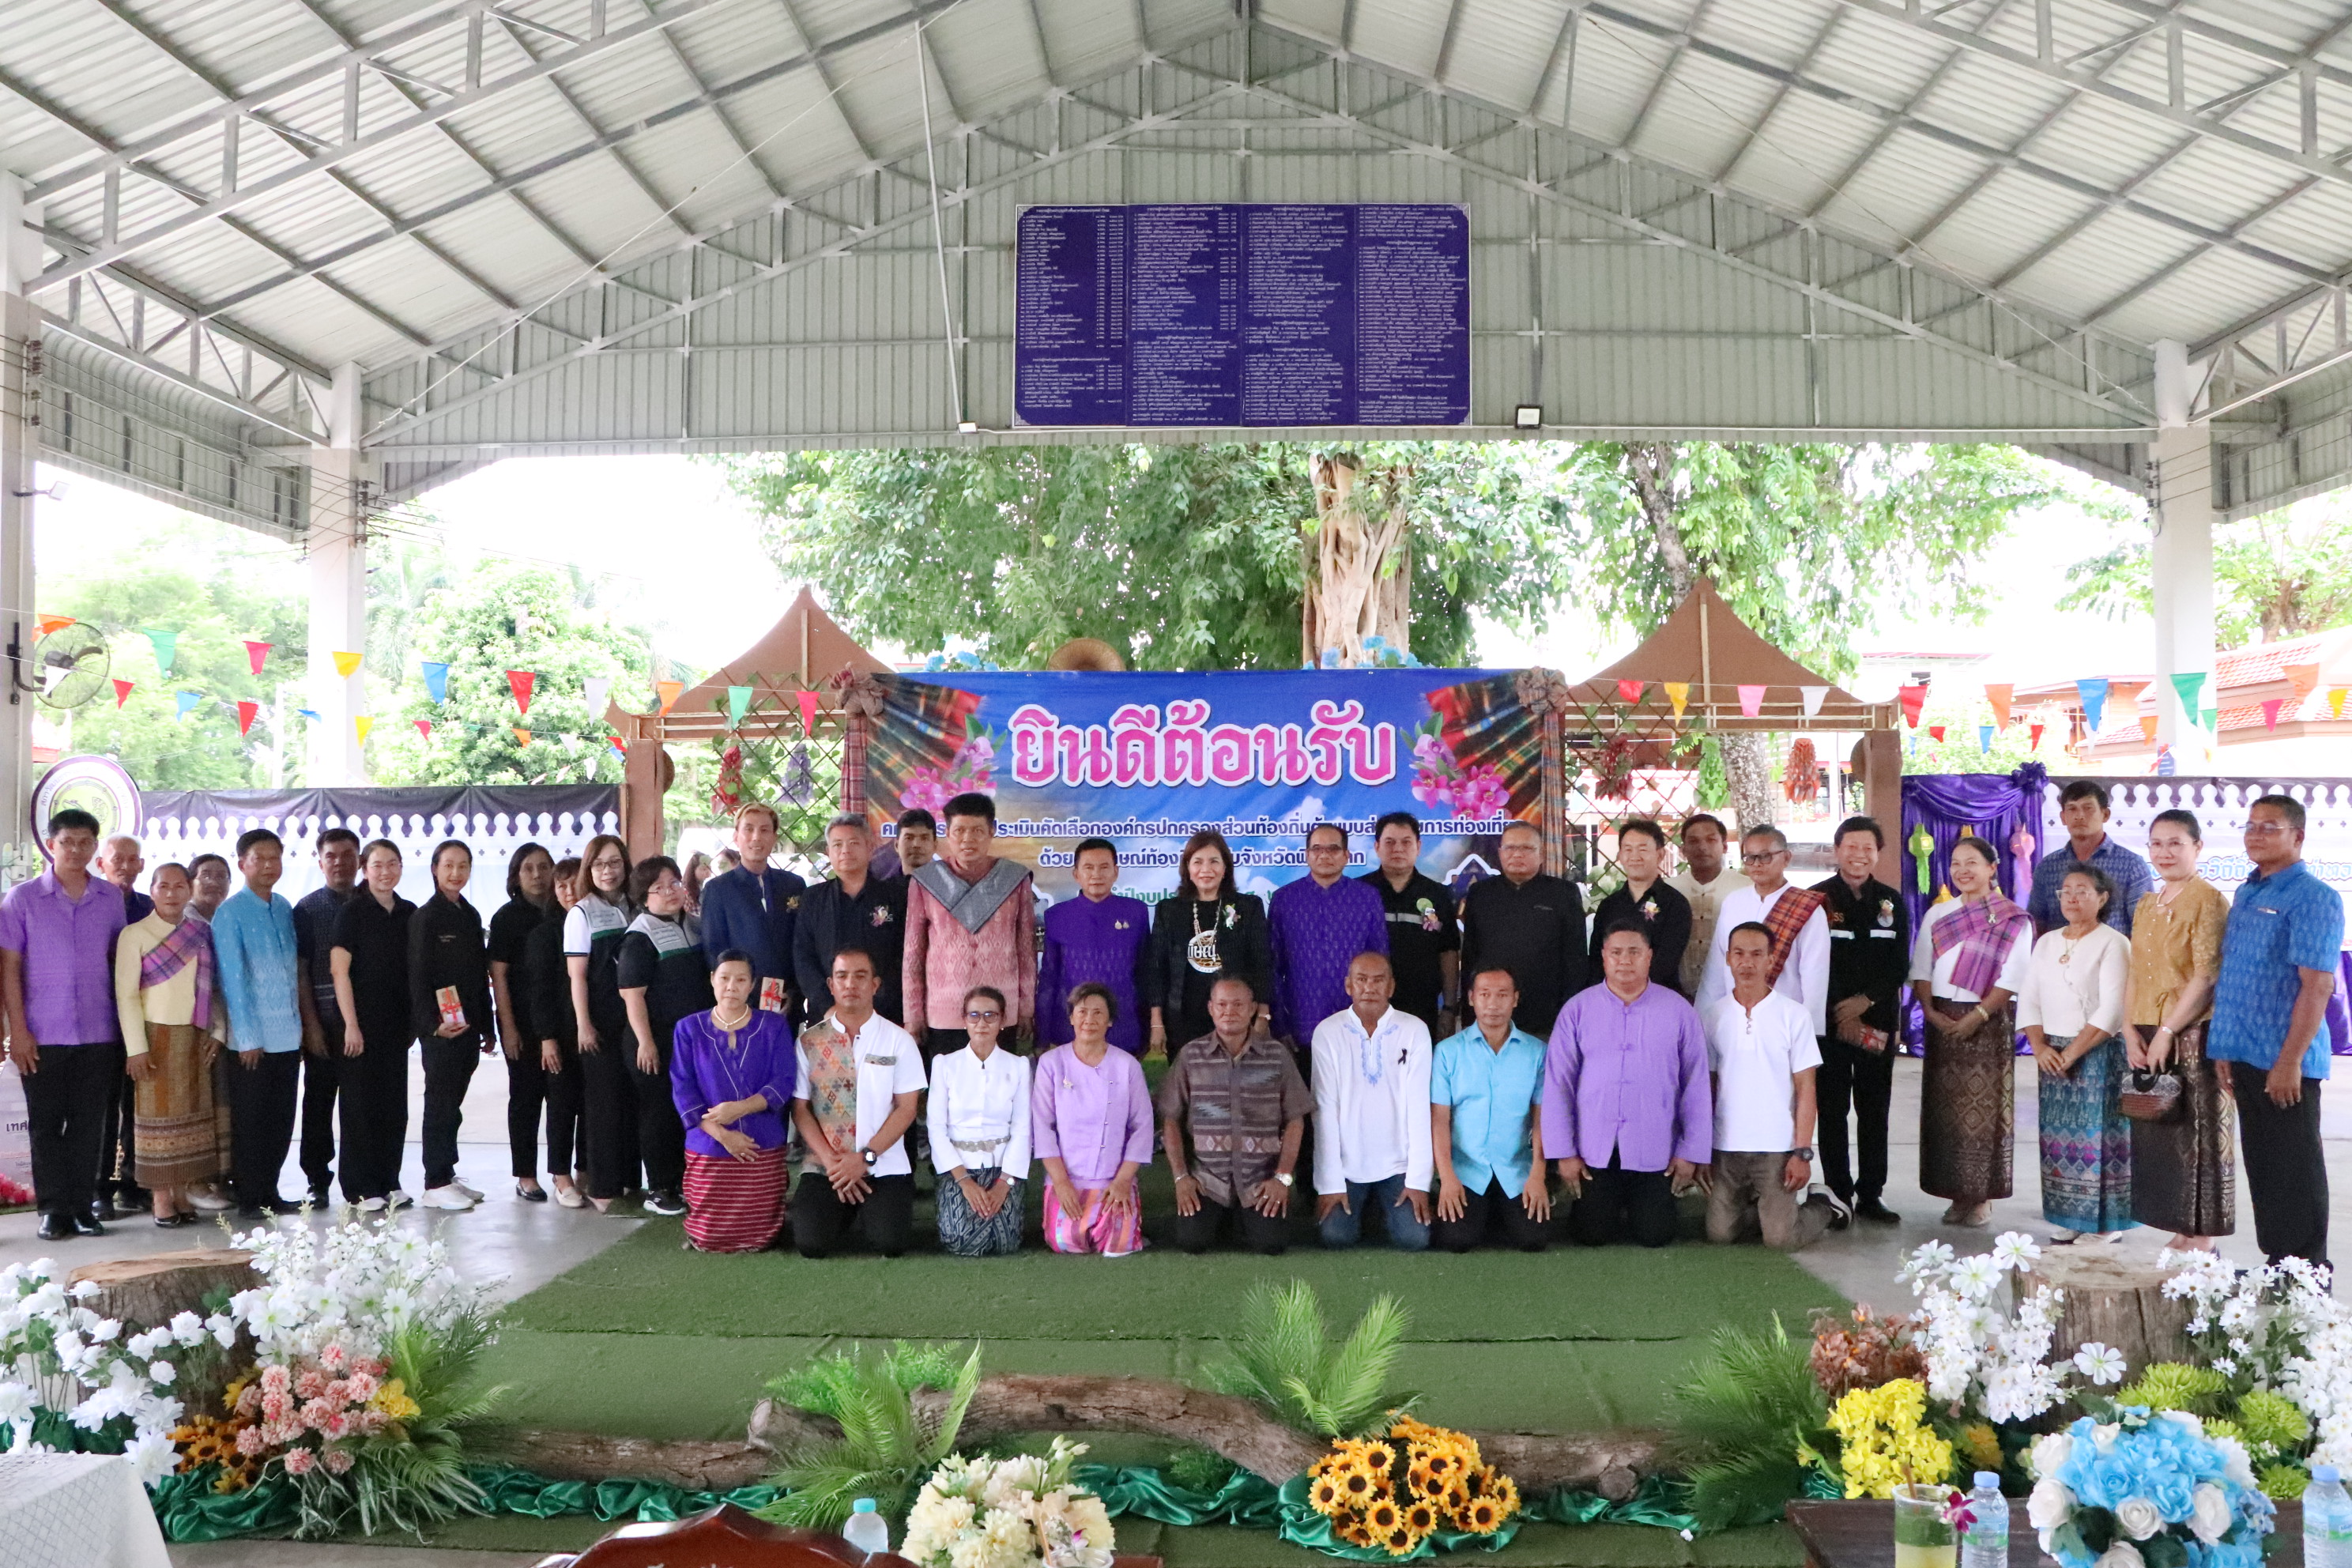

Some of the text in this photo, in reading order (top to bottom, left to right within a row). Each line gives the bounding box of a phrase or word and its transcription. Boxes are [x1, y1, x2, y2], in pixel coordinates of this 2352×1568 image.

[1011, 700, 1394, 785] ยินดีต้อนรับ
